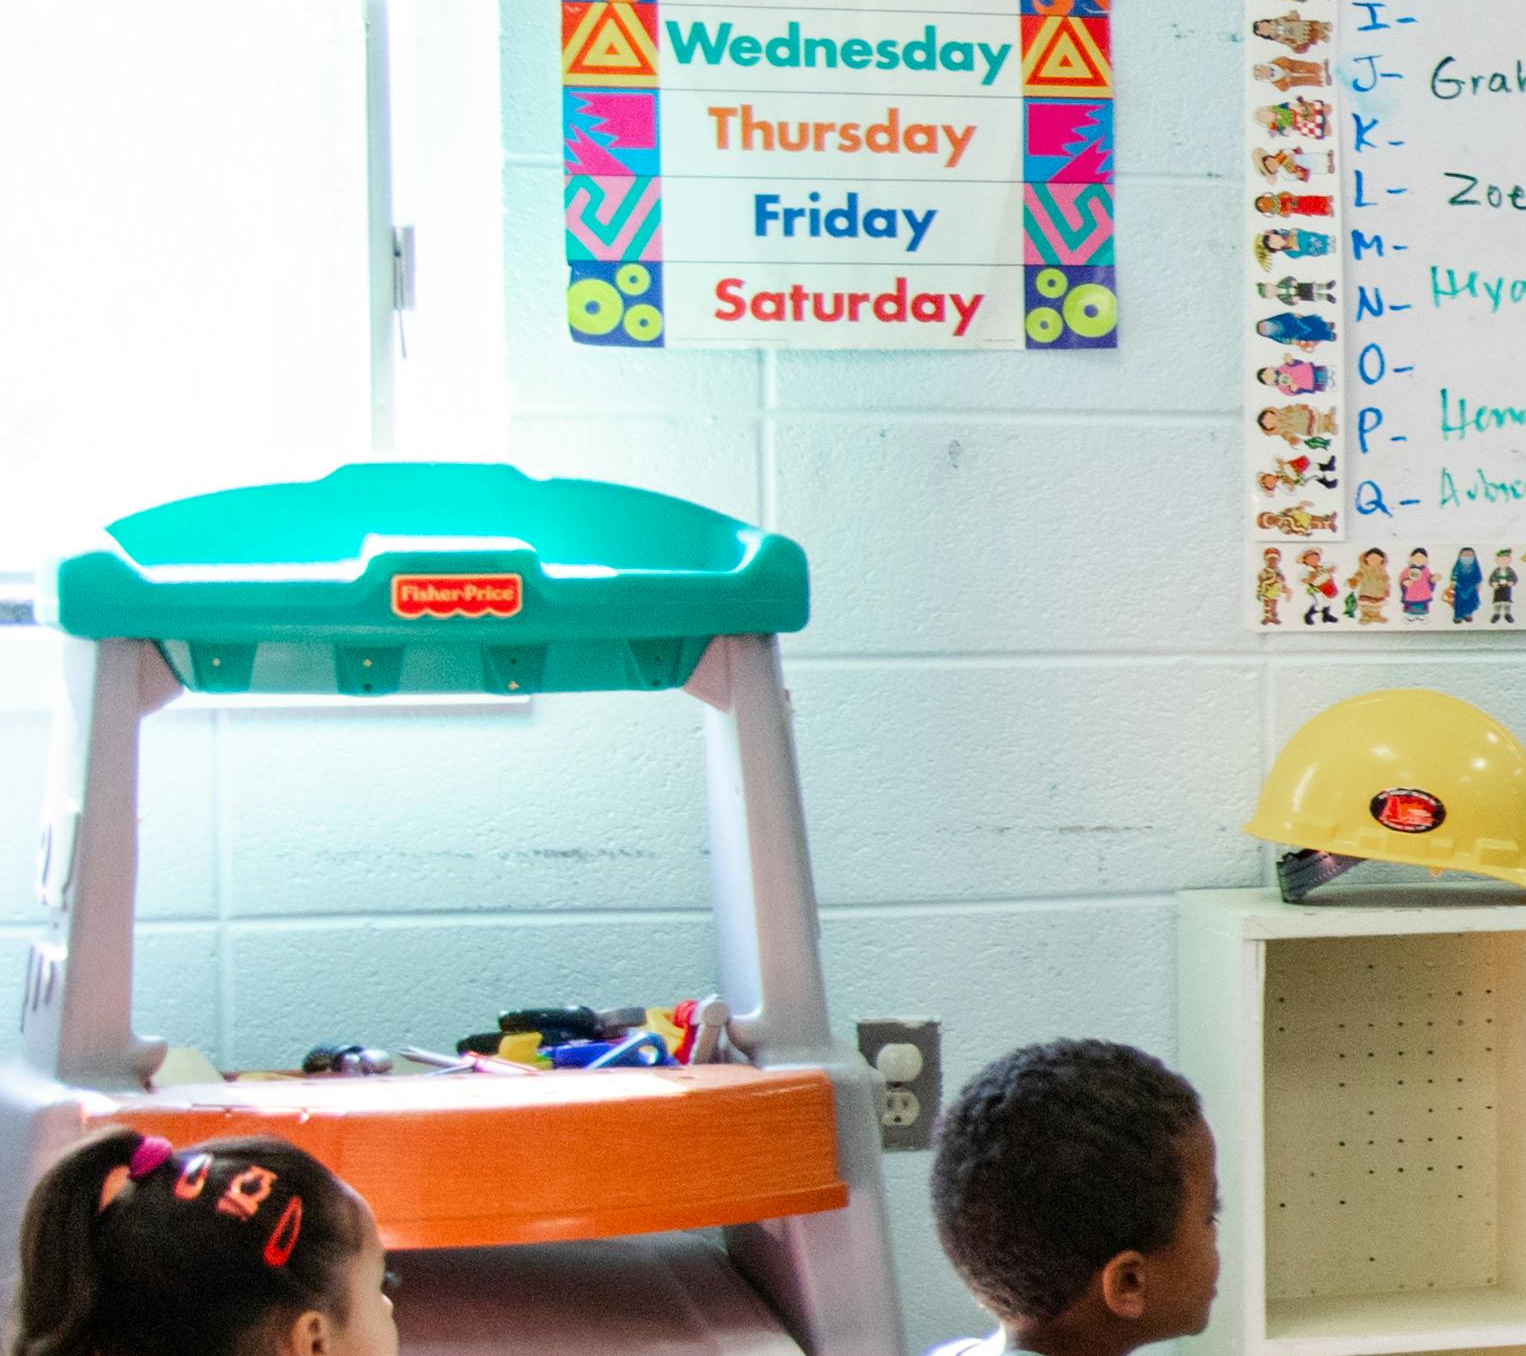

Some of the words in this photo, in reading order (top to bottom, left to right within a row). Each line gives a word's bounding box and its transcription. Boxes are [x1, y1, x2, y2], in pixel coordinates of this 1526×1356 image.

[665, 20, 1012, 86] Wednesday
[708, 105, 977, 168] Thursday
[755, 192, 937, 252] Friday
[715, 277, 984, 337] Saturday
[401, 584, 514, 602] Fisher-Price
